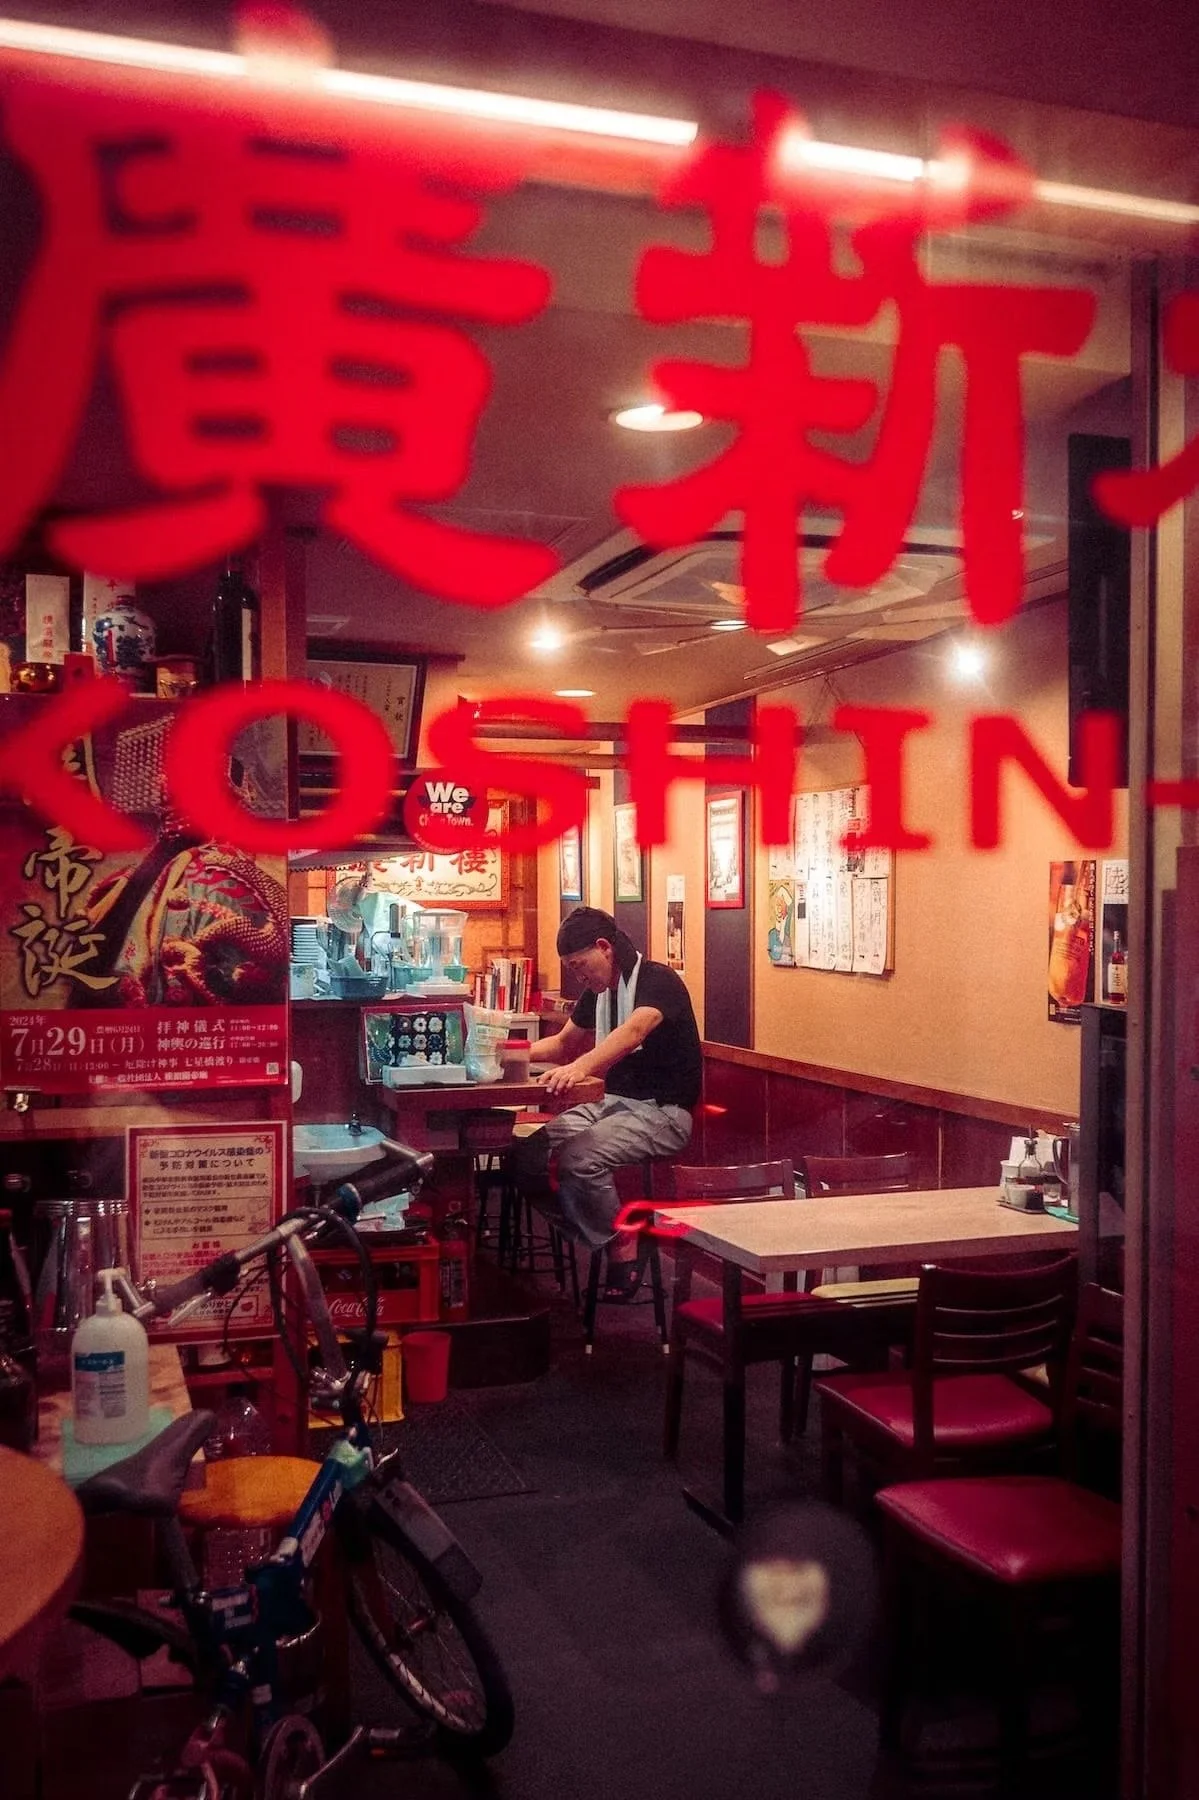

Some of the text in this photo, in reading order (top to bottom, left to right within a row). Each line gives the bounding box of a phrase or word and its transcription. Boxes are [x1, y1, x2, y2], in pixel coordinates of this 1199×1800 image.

[0, 2, 1199, 632] 廣新
[424, 781, 469, 803] We
[430, 802, 464, 814] are
